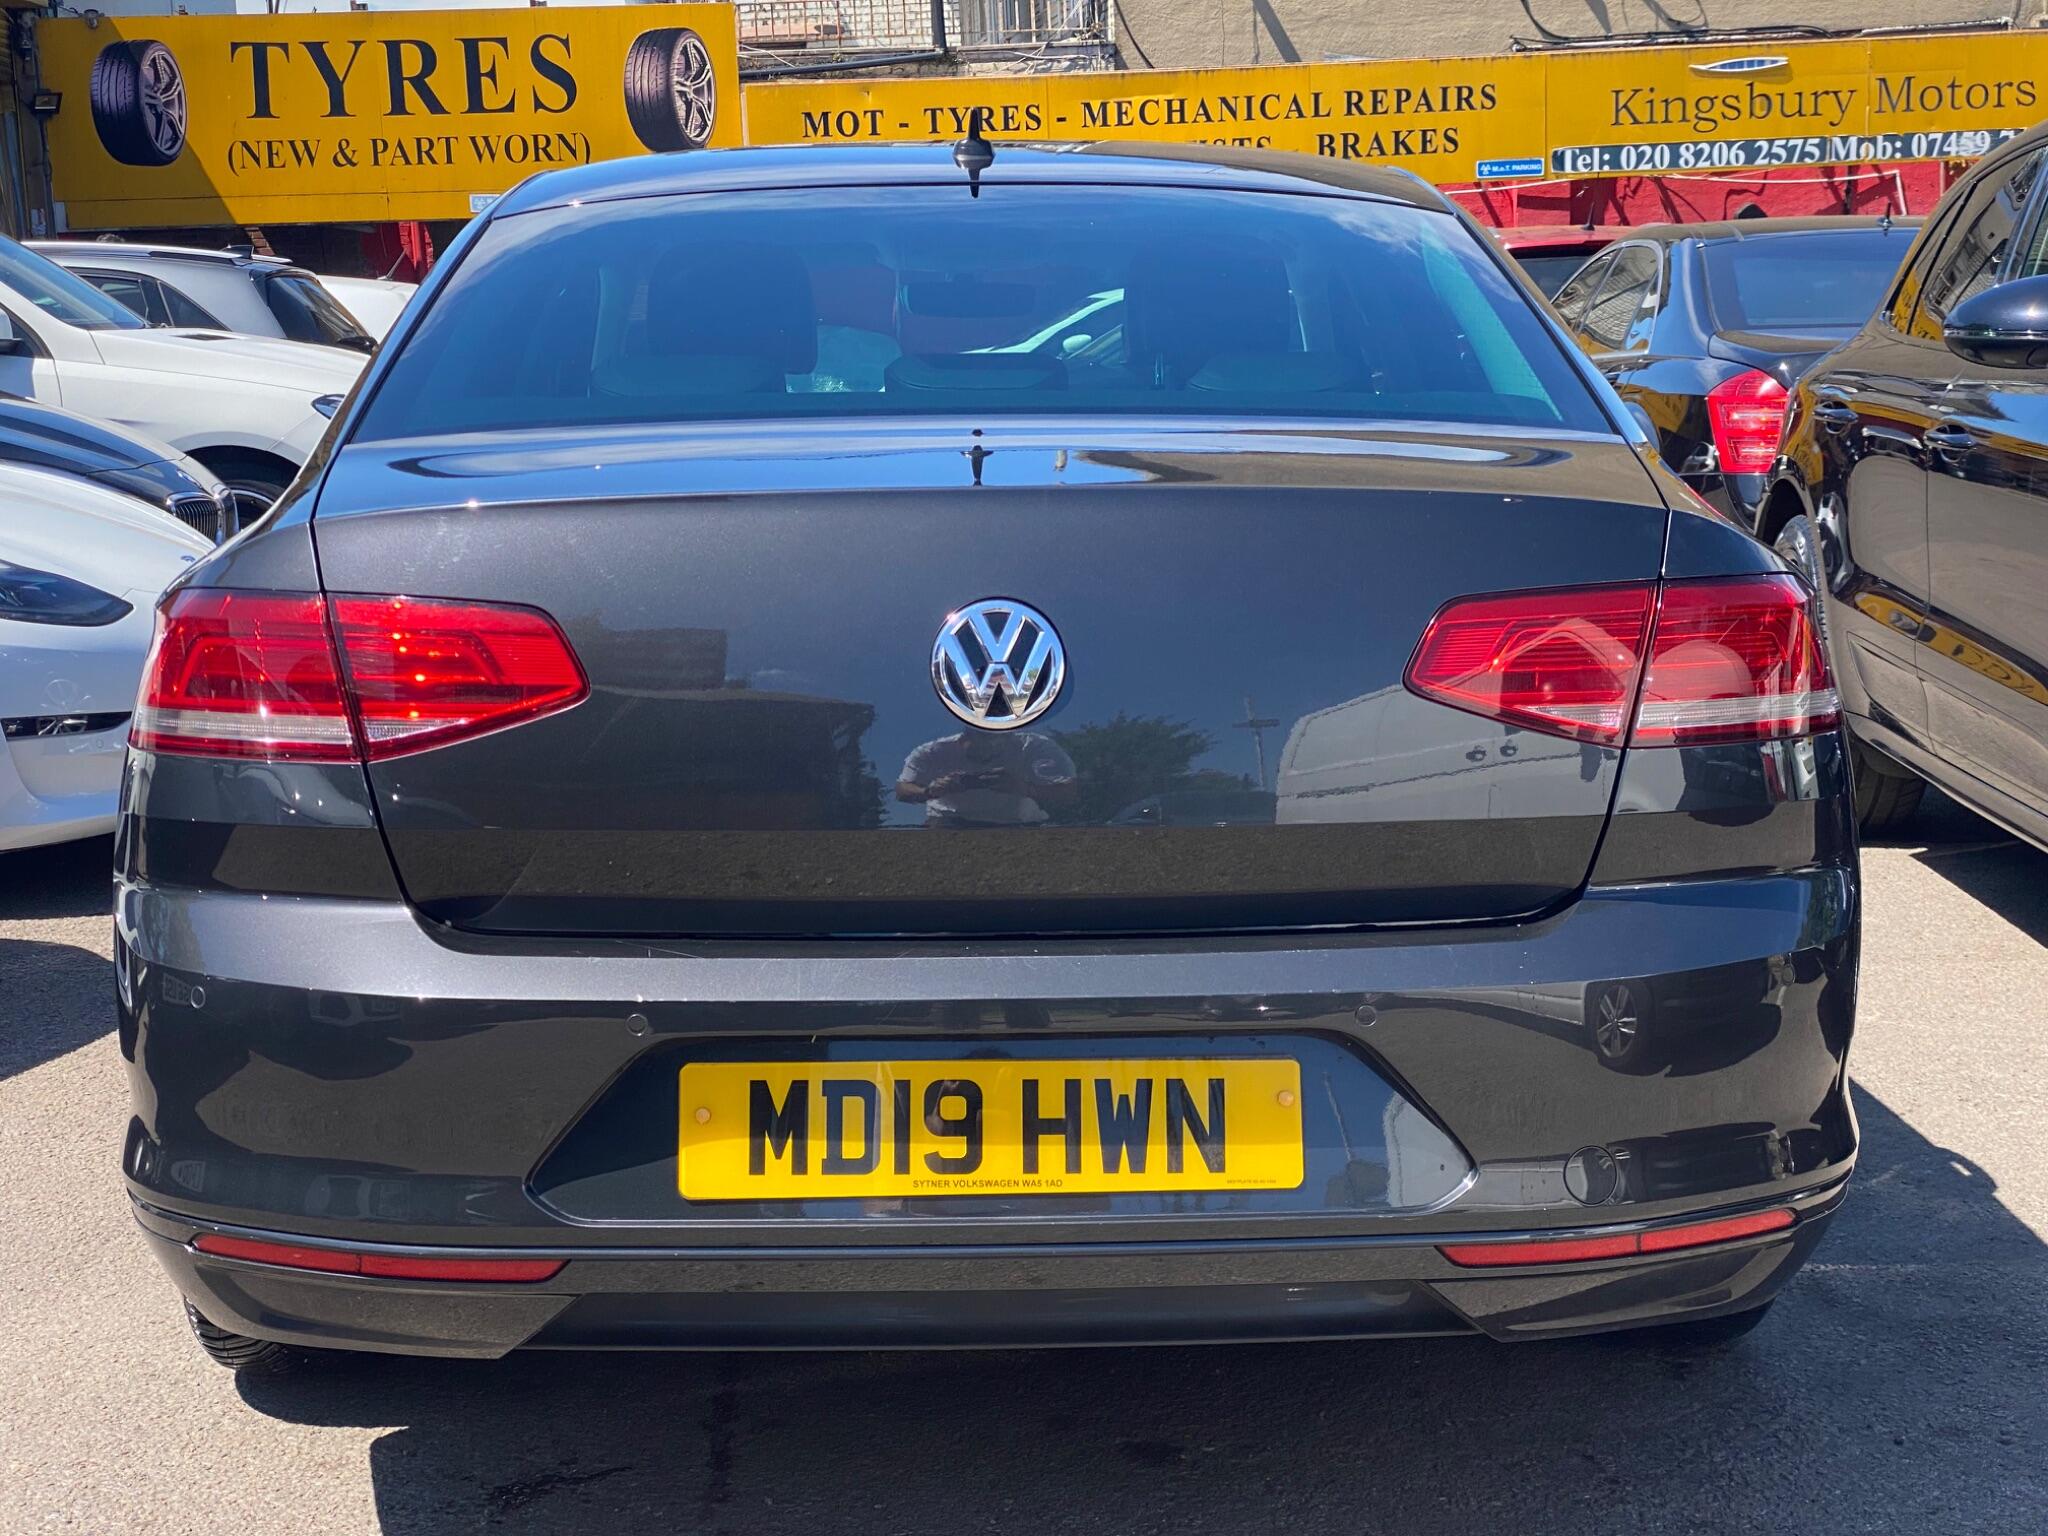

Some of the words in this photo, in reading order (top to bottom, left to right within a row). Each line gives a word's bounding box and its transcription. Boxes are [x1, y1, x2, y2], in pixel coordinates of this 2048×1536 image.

[230, 33, 578, 120] TYRES
[801, 109, 885, 138] MOT
[923, 103, 1042, 134] TYRES
[1080, 90, 1332, 129] MECHANICAL
[1342, 82, 1498, 117] REPAIRS
[1610, 82, 1857, 134] Kingsbury
[1873, 75, 2038, 115] Motors
[227, 138, 321, 177] (NEW
[331, 137, 360, 168] &
[370, 135, 459, 167] PART
[467, 131, 592, 167] WORN)
[1315, 127, 1460, 159] BRAKES
[1558, 146, 1610, 173] Tel:
[1620, 144, 1671, 171] 020
[1678, 141, 1746, 168] 8206
[1753, 137, 1821, 166] 2575
[1829, 134, 1903, 162] Mob:
[748, 1079, 983, 1177] MD19
[1022, 1077, 1227, 1175] HWN
[912, 1179, 950, 1189] SYTNER
[953, 1178, 1020, 1188] VOLKSWAGEN
[1022, 1178, 1042, 1188] WA5
